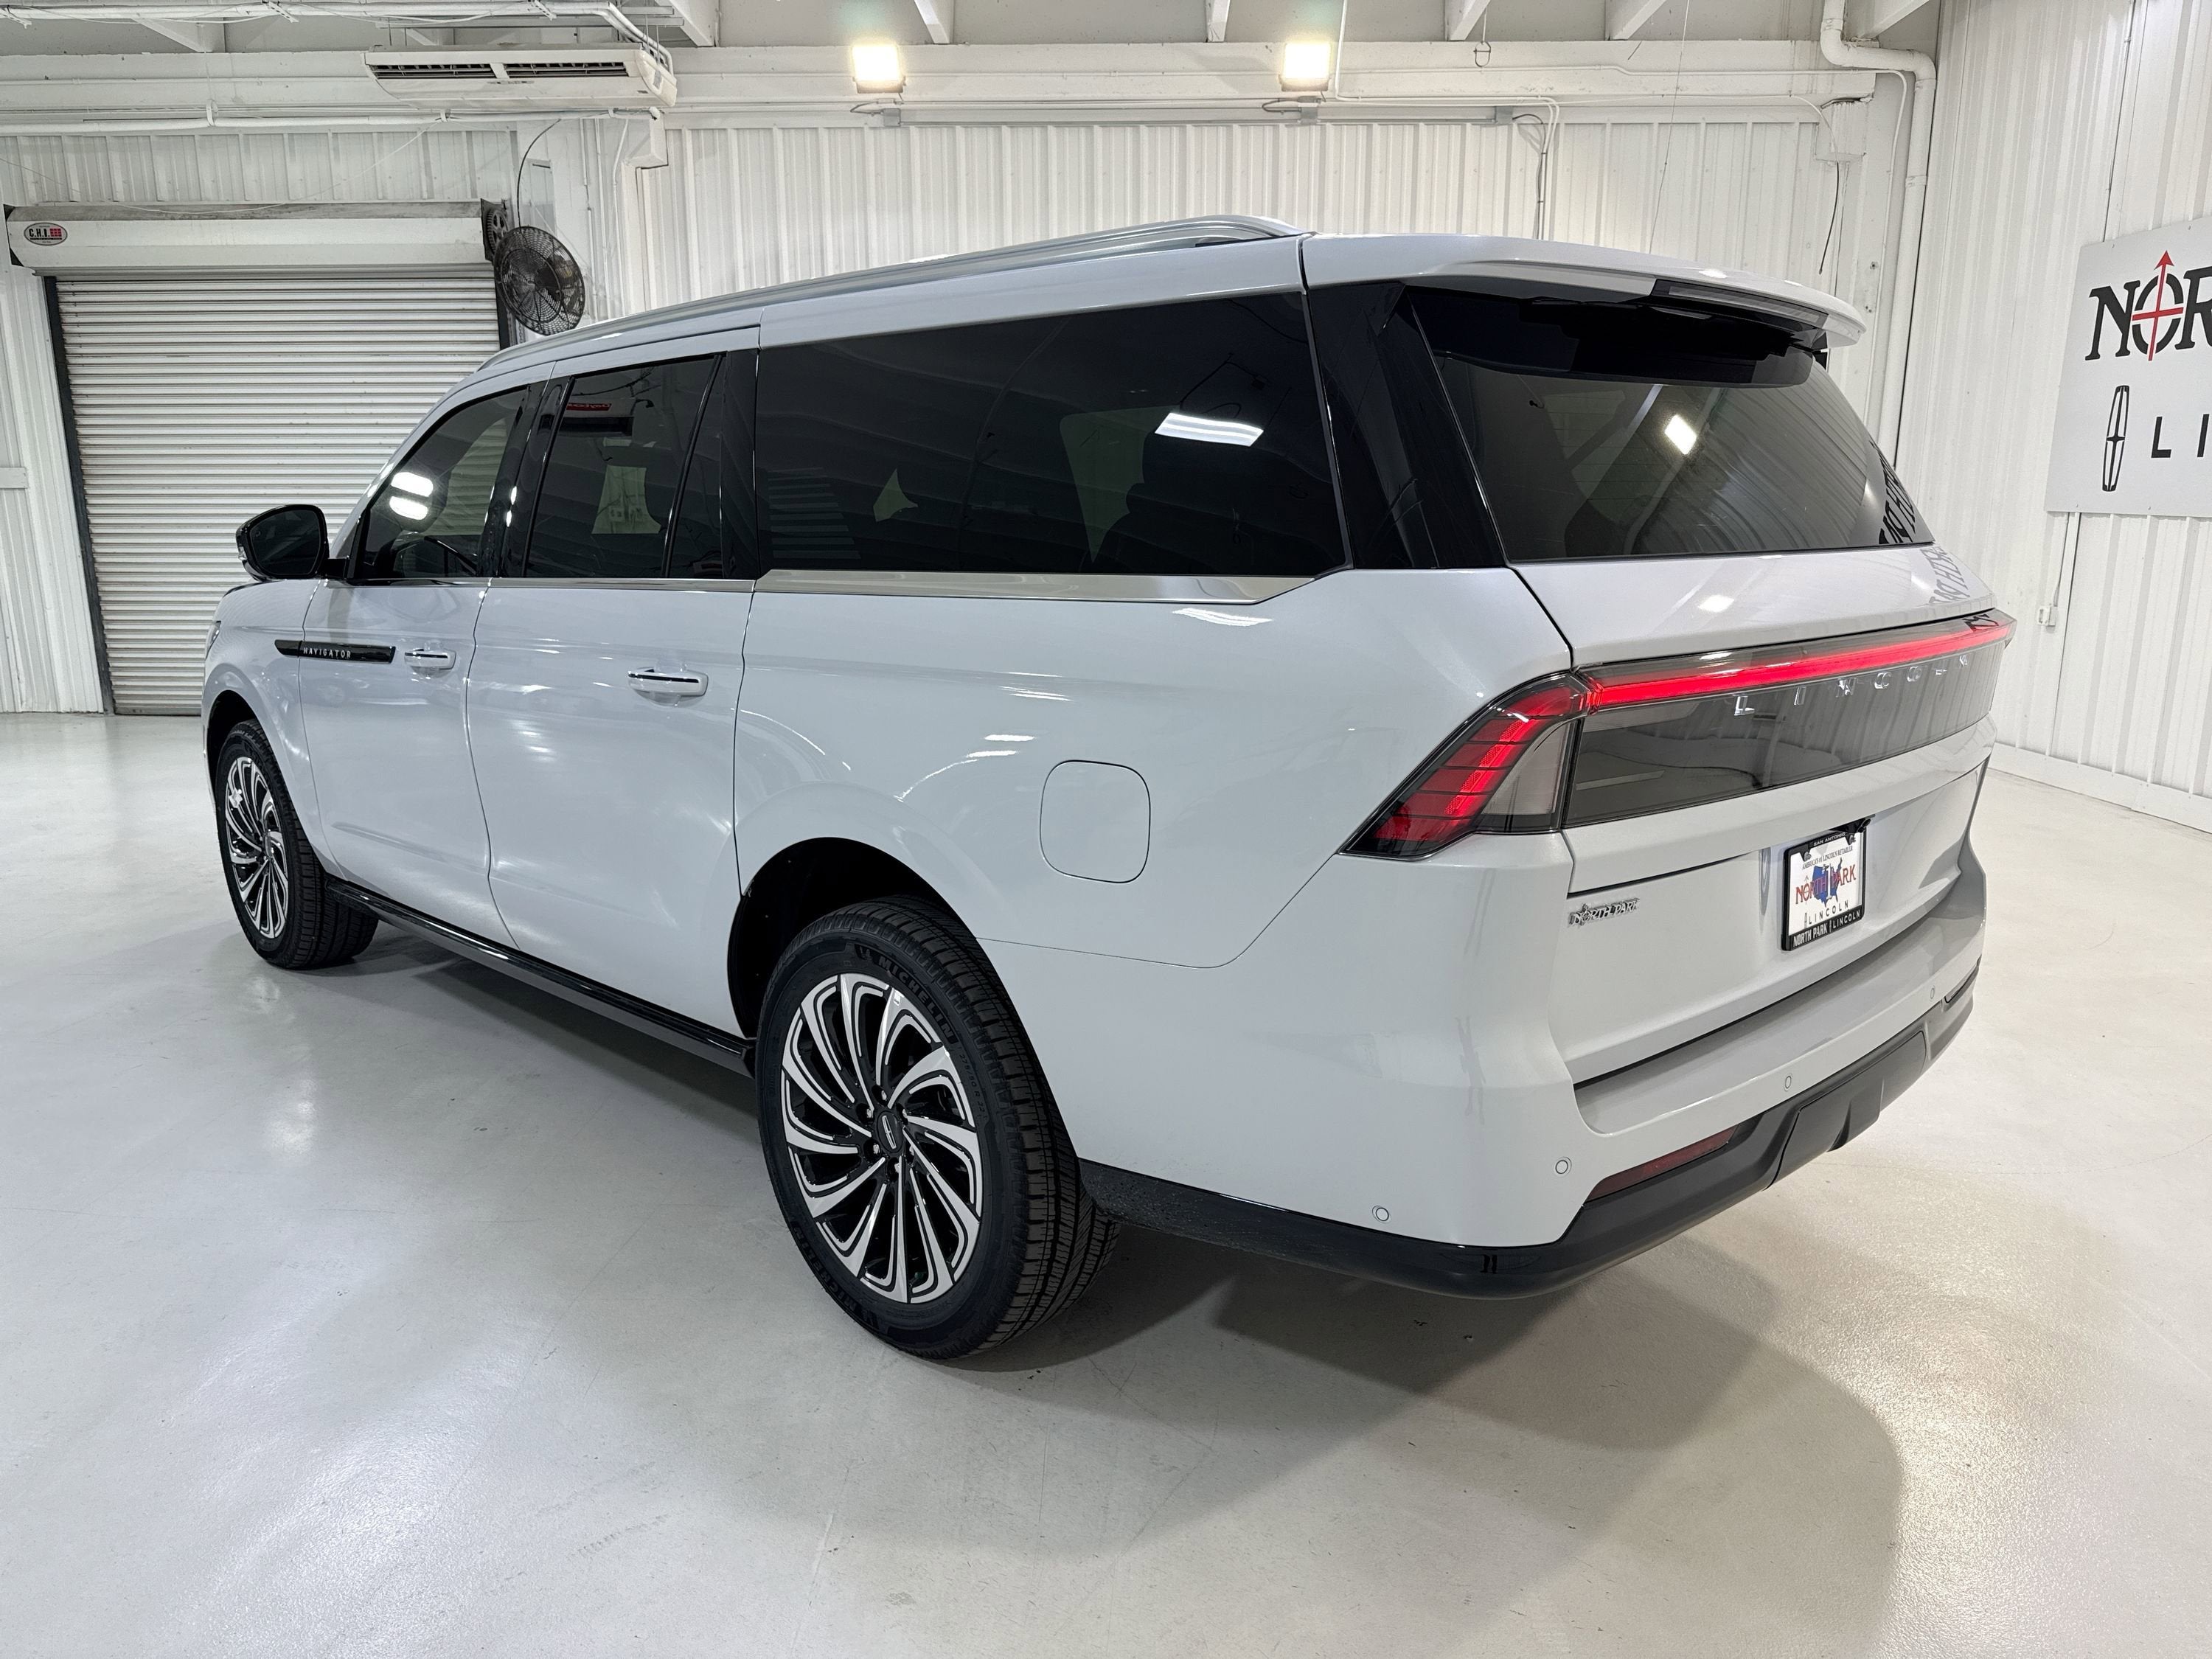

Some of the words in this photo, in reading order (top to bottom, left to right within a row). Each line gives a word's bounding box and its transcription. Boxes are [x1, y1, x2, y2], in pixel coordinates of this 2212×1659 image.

[2151, 414, 2210, 459] LI
[303, 647, 351, 658] NAVIGATOR
[1825, 832, 1846, 844] ANTONIO
[1795, 874, 1827, 905] NORTH
[1832, 863, 1857, 889] PARK
[1568, 904, 1610, 926] NORTH
[1792, 930, 1812, 947] NORTH
[1812, 923, 1827, 939] PARK
[1832, 910, 1860, 929] LINCOLN
[1808, 900, 1849, 925] LINCOLN
[877, 956, 954, 1040] MICHELIN
[793, 1227, 858, 1311] MICHELIN
